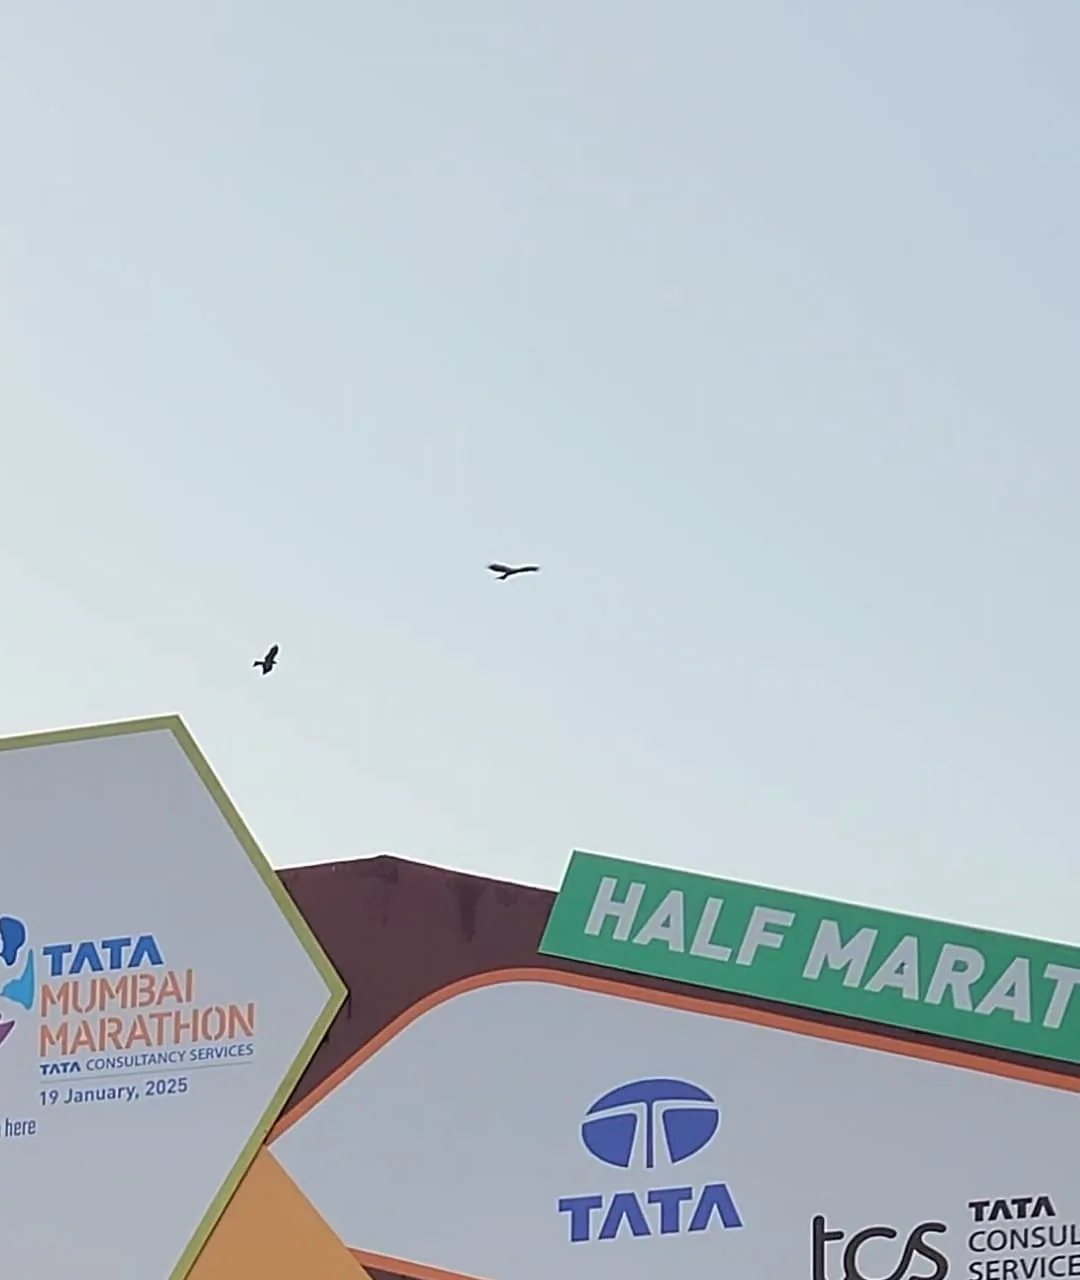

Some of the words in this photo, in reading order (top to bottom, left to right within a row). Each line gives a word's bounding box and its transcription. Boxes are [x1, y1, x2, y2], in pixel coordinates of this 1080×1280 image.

[43, 935, 164, 976] TATA
[583, 876, 796, 966] HALF
[802, 919, 1080, 1029] MARAT
[41, 969, 193, 1017] MUMBAI
[39, 1003, 255, 1057] MARATHON
[39, 1061, 81, 1077] TATA
[86, 1050, 187, 1071] CONSULTANCY
[189, 1043, 254, 1061] SERVICES
[40, 1090, 59, 1106] 19
[63, 1082, 140, 1105] January,
[145, 1077, 188, 1096] 2025
[5, 1118, 36, 1138] here
[558, 1183, 743, 1243] TATA
[968, 1196, 1056, 1222] TATA
[968, 1224, 1080, 1252] CONSUL
